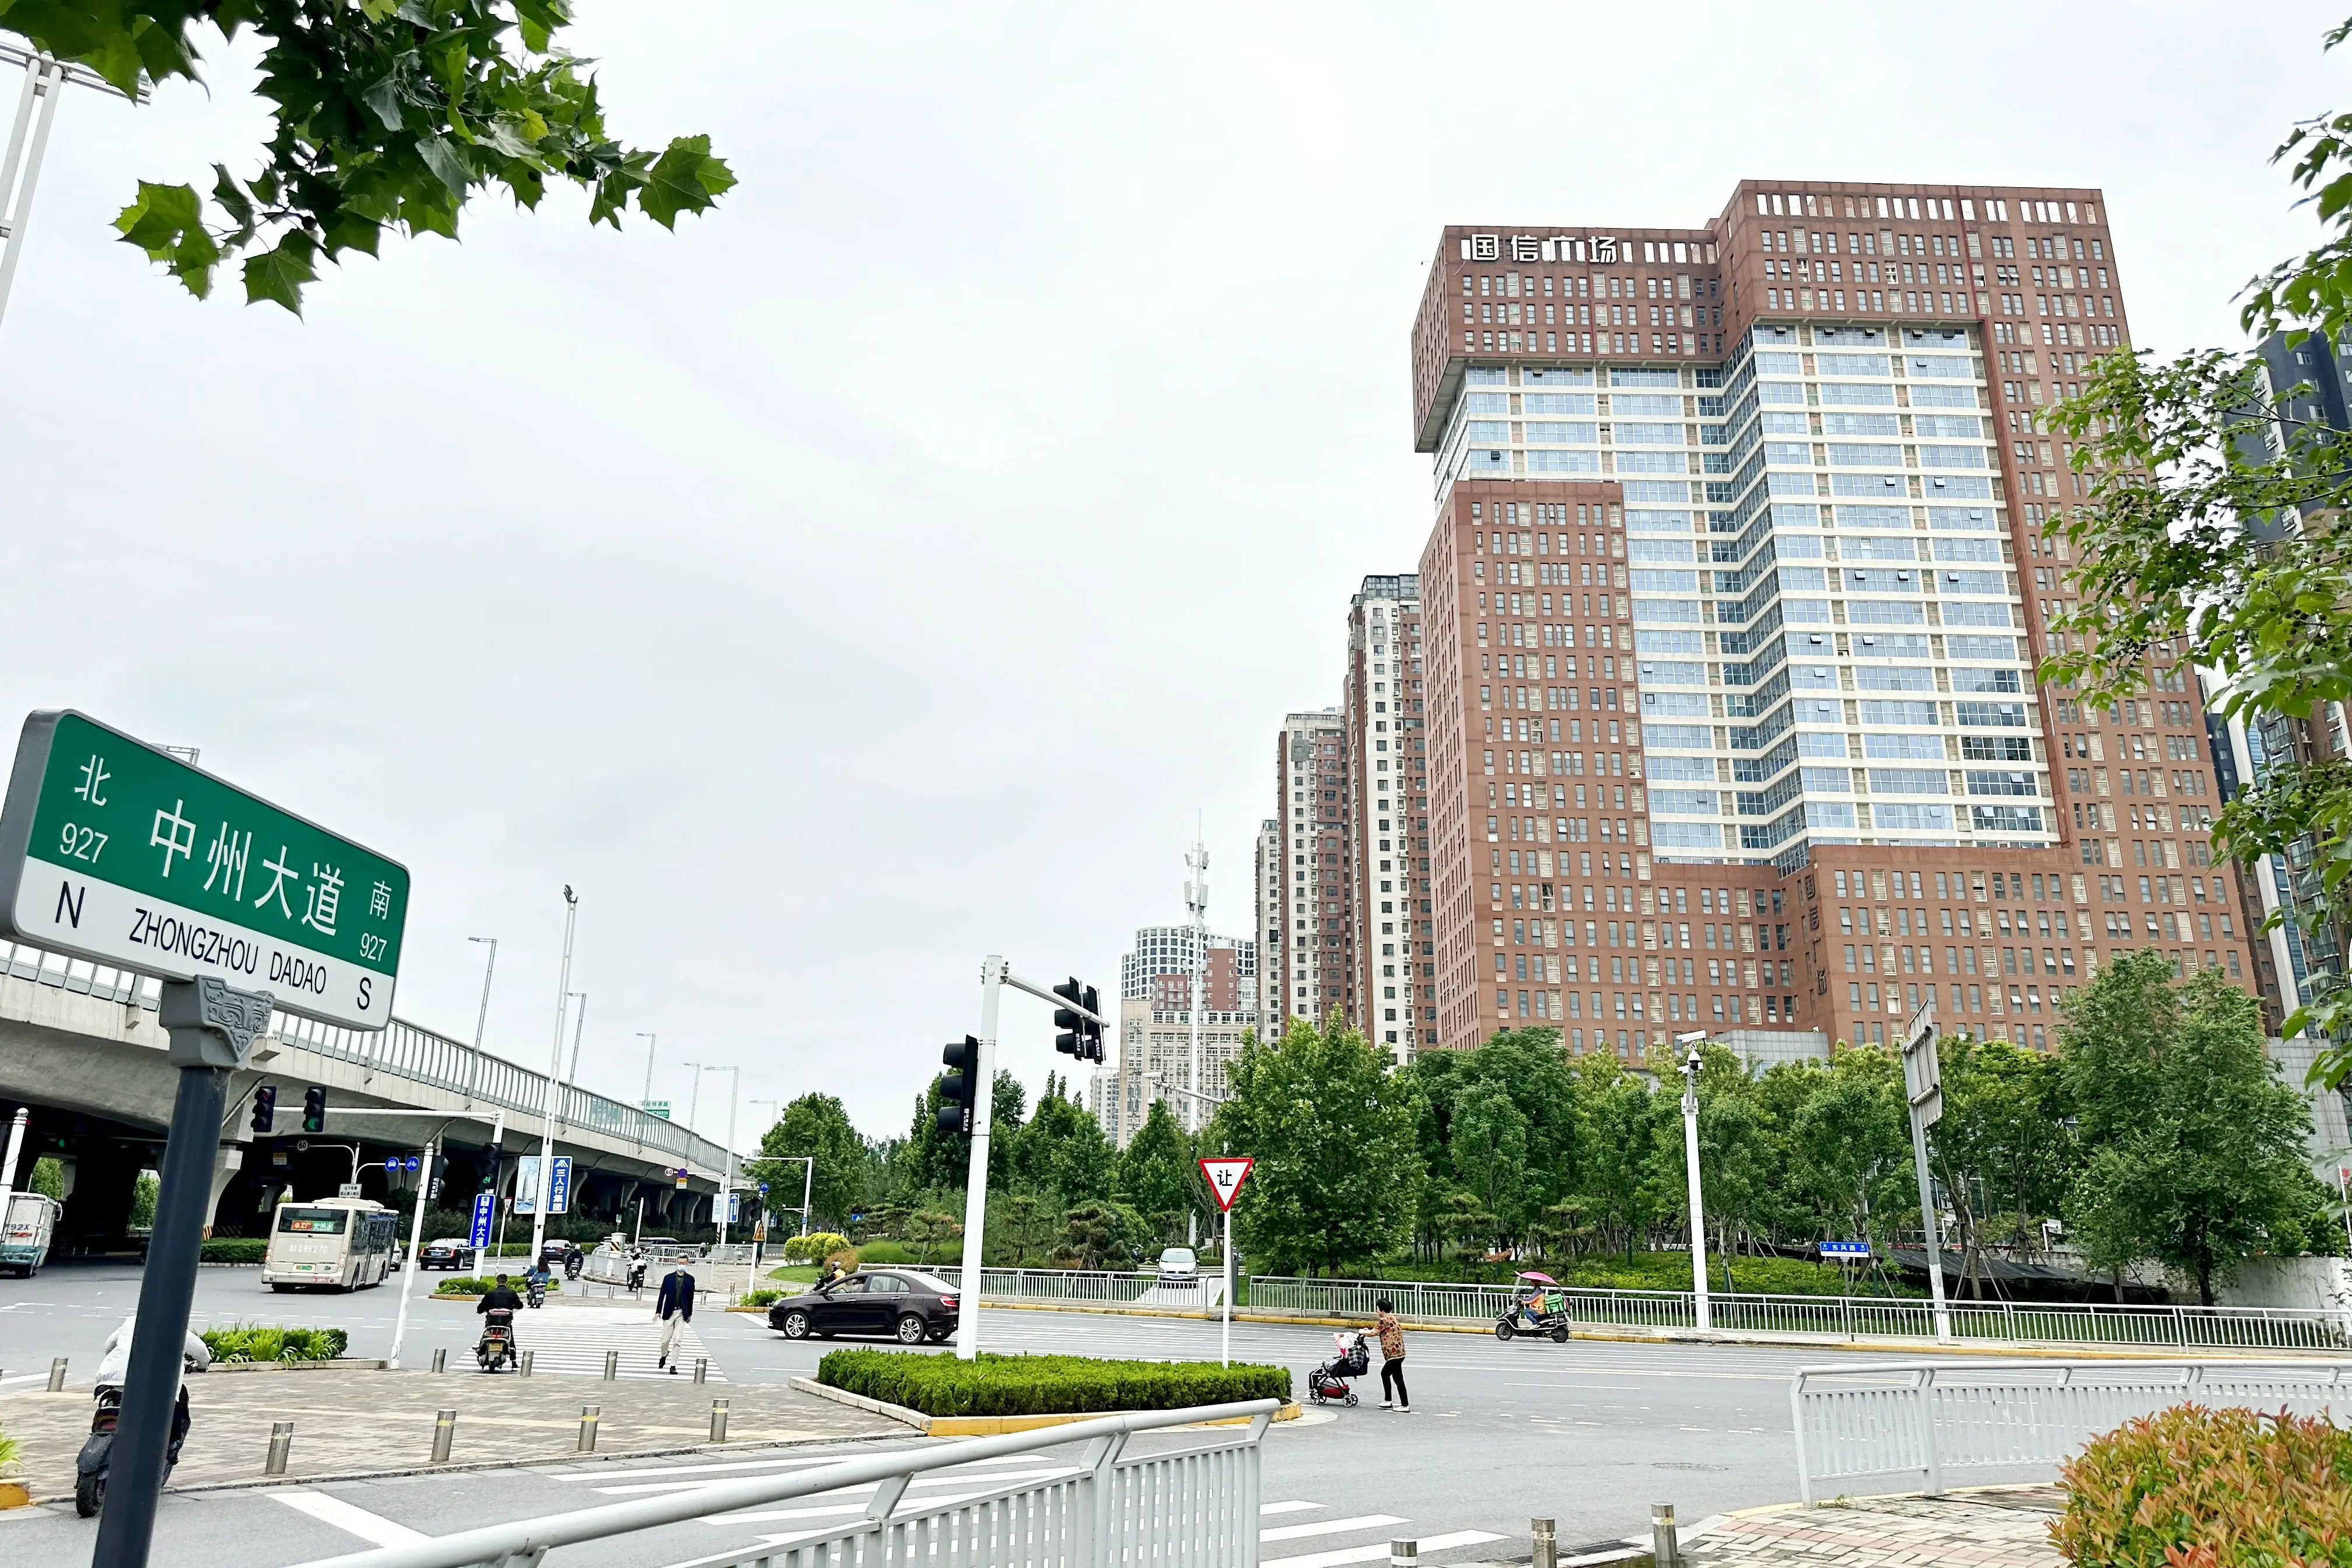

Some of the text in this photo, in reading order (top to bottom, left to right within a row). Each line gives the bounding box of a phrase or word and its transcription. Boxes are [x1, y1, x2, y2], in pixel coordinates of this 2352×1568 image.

[1471, 234, 1618, 263] 国信广场
[74, 754, 111, 806] 北
[60, 822, 109, 863] 927
[150, 798, 345, 936] 中州大道
[55, 881, 86, 929] N
[369, 880, 393, 920] 南
[129, 908, 326, 994] ZHONGZHOU DADAO
[359, 932, 387, 963] 927
[357, 977, 372, 1010] S
[298, 1140, 306, 1149] 60
[552, 1168, 566, 1212] 三人行集团
[1217, 1169, 1233, 1186] 让
[475, 1206, 488, 1247] 中州大道
